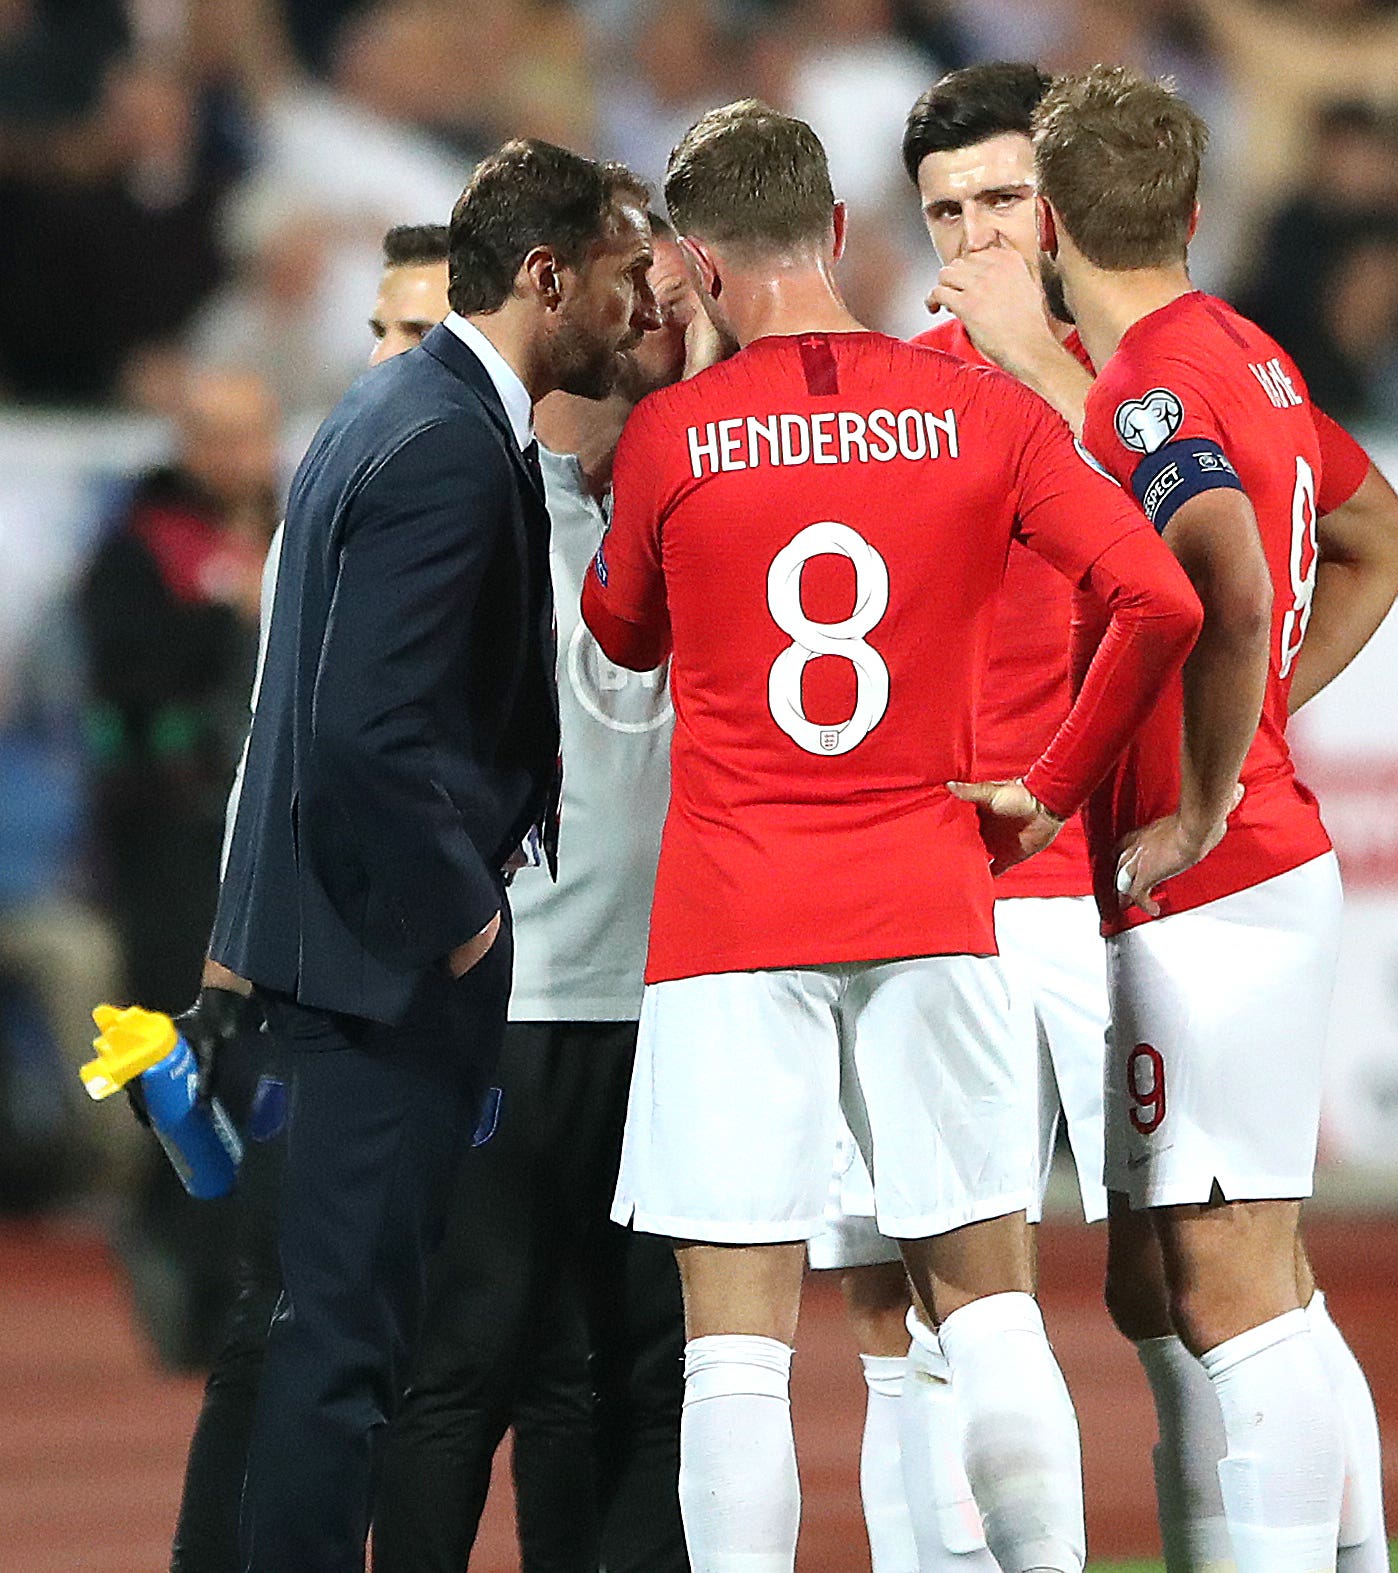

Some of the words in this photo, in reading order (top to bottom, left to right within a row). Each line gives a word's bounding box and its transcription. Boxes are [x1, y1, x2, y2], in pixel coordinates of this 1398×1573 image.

[687, 407, 960, 479] HENDERSON
[1144, 465, 1179, 521] ESPECT
[766, 520, 890, 757] 8
[1126, 1042, 1166, 1135] 9
